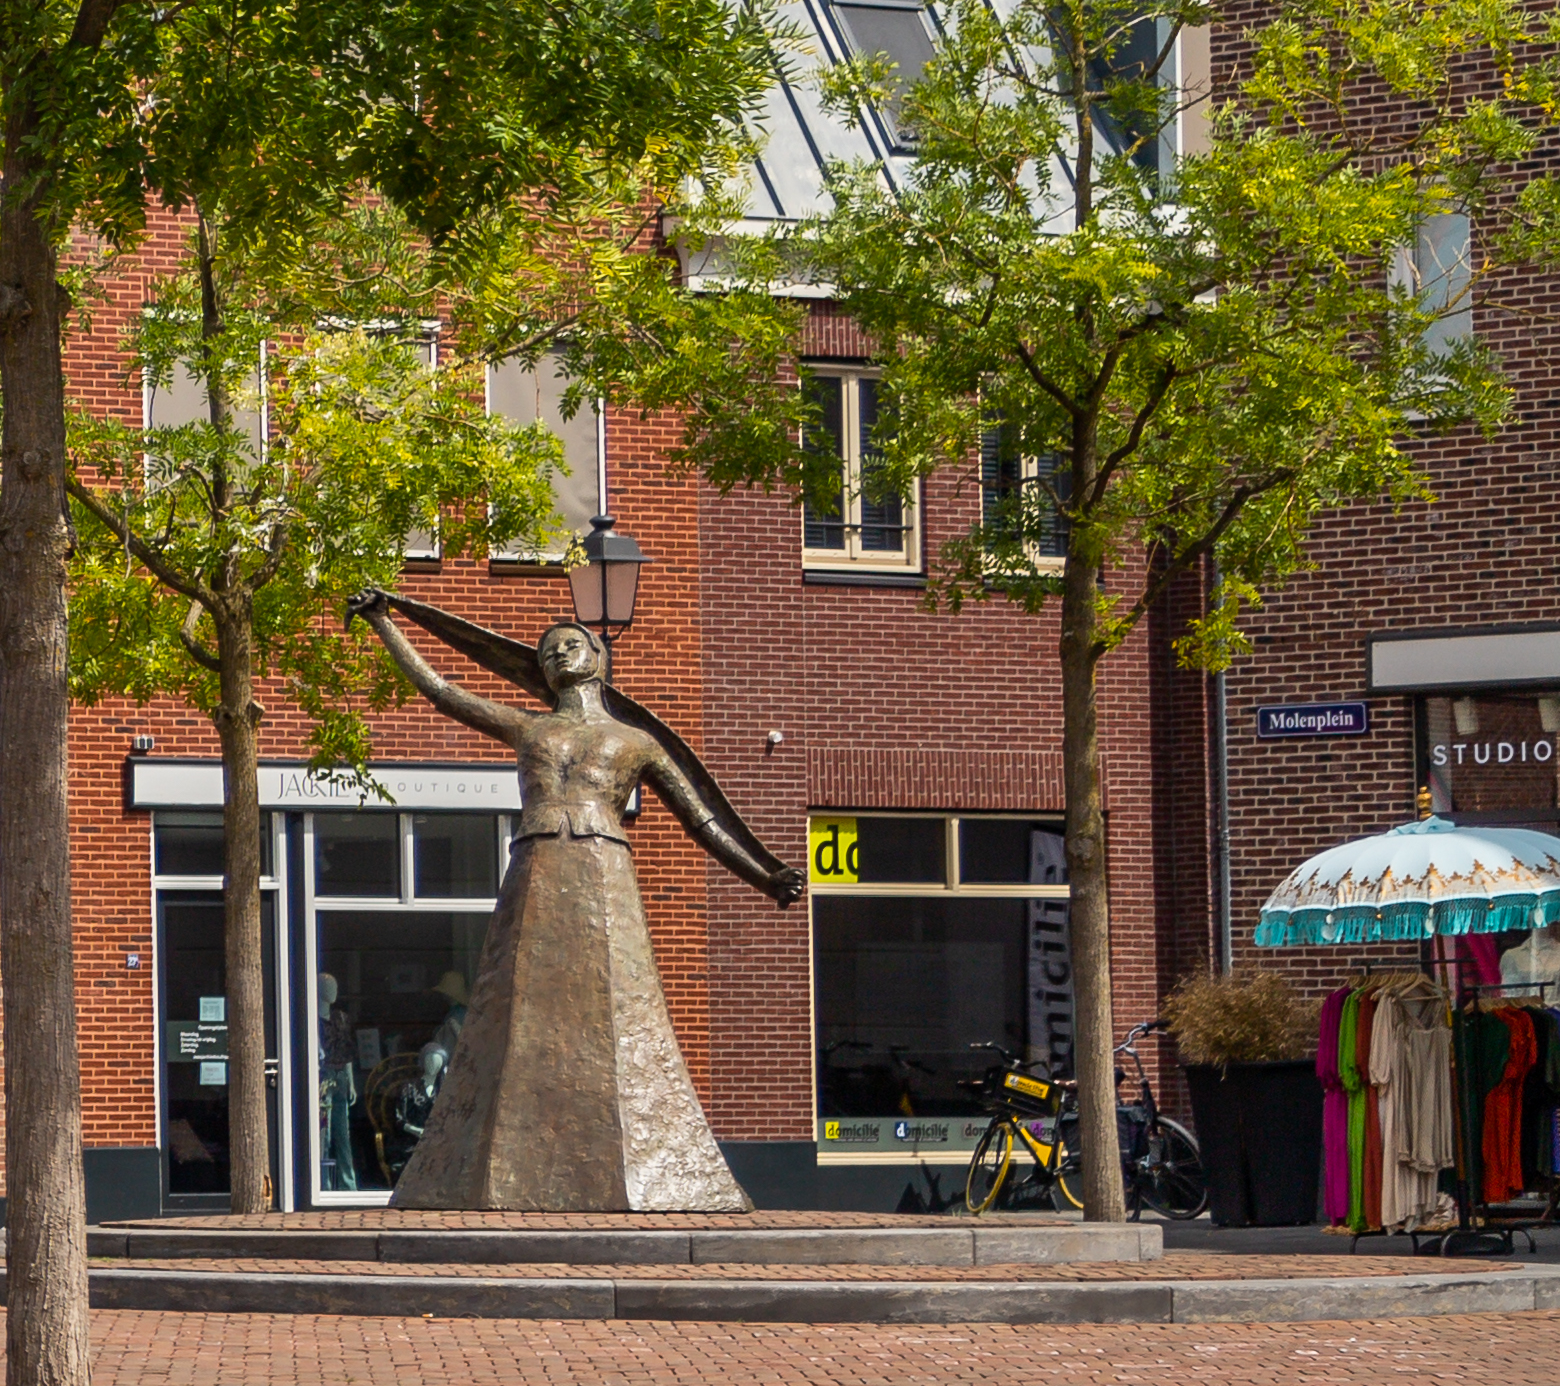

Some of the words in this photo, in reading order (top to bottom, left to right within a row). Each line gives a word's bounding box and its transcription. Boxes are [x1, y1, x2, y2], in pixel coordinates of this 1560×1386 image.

[1269, 709, 1354, 732] Molenplein
[1433, 740, 1552, 766] STUDIO
[382, 782, 498, 795] BOUTIQUE
